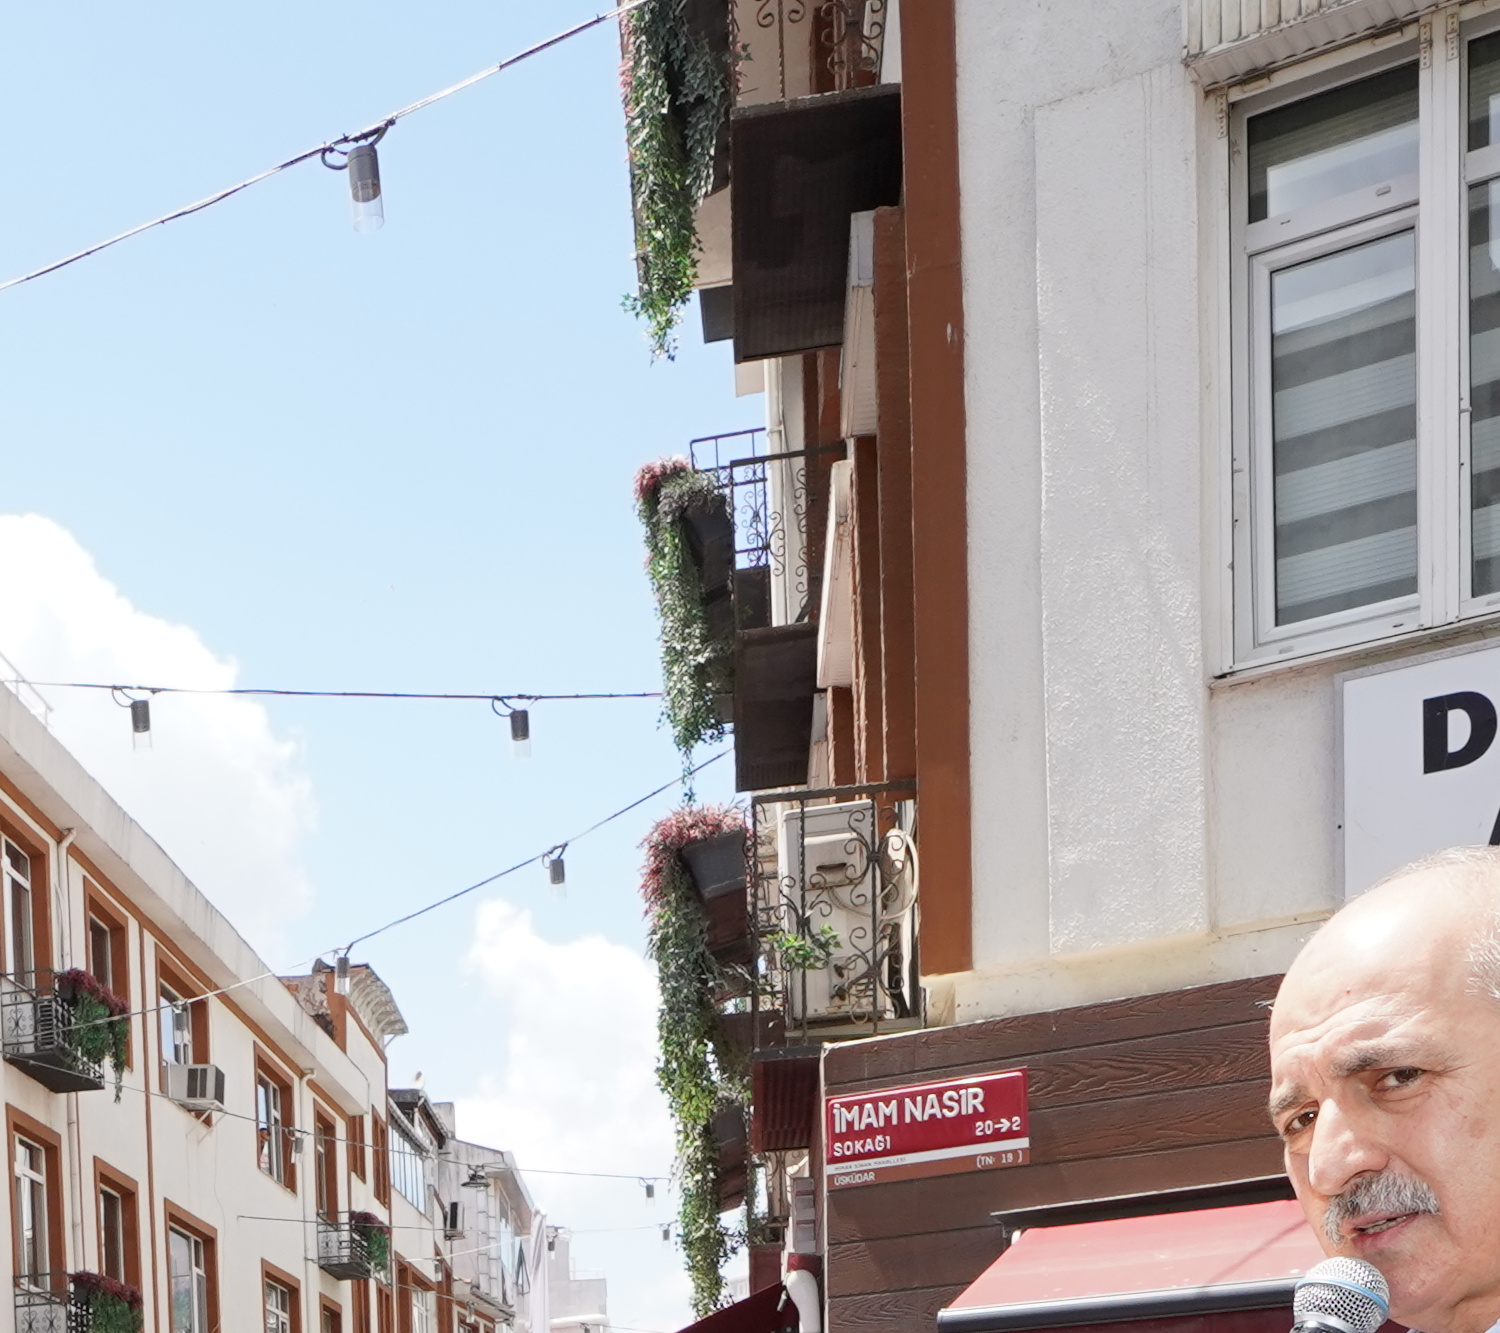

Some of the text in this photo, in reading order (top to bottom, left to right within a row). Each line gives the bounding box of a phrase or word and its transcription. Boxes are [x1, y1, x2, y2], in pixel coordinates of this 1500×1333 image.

[833, 1087, 985, 1134] İMAM NASIR
[833, 1135, 892, 1157] SOKAĞI
[834, 1171, 876, 1187] ÜSKÜDAR
